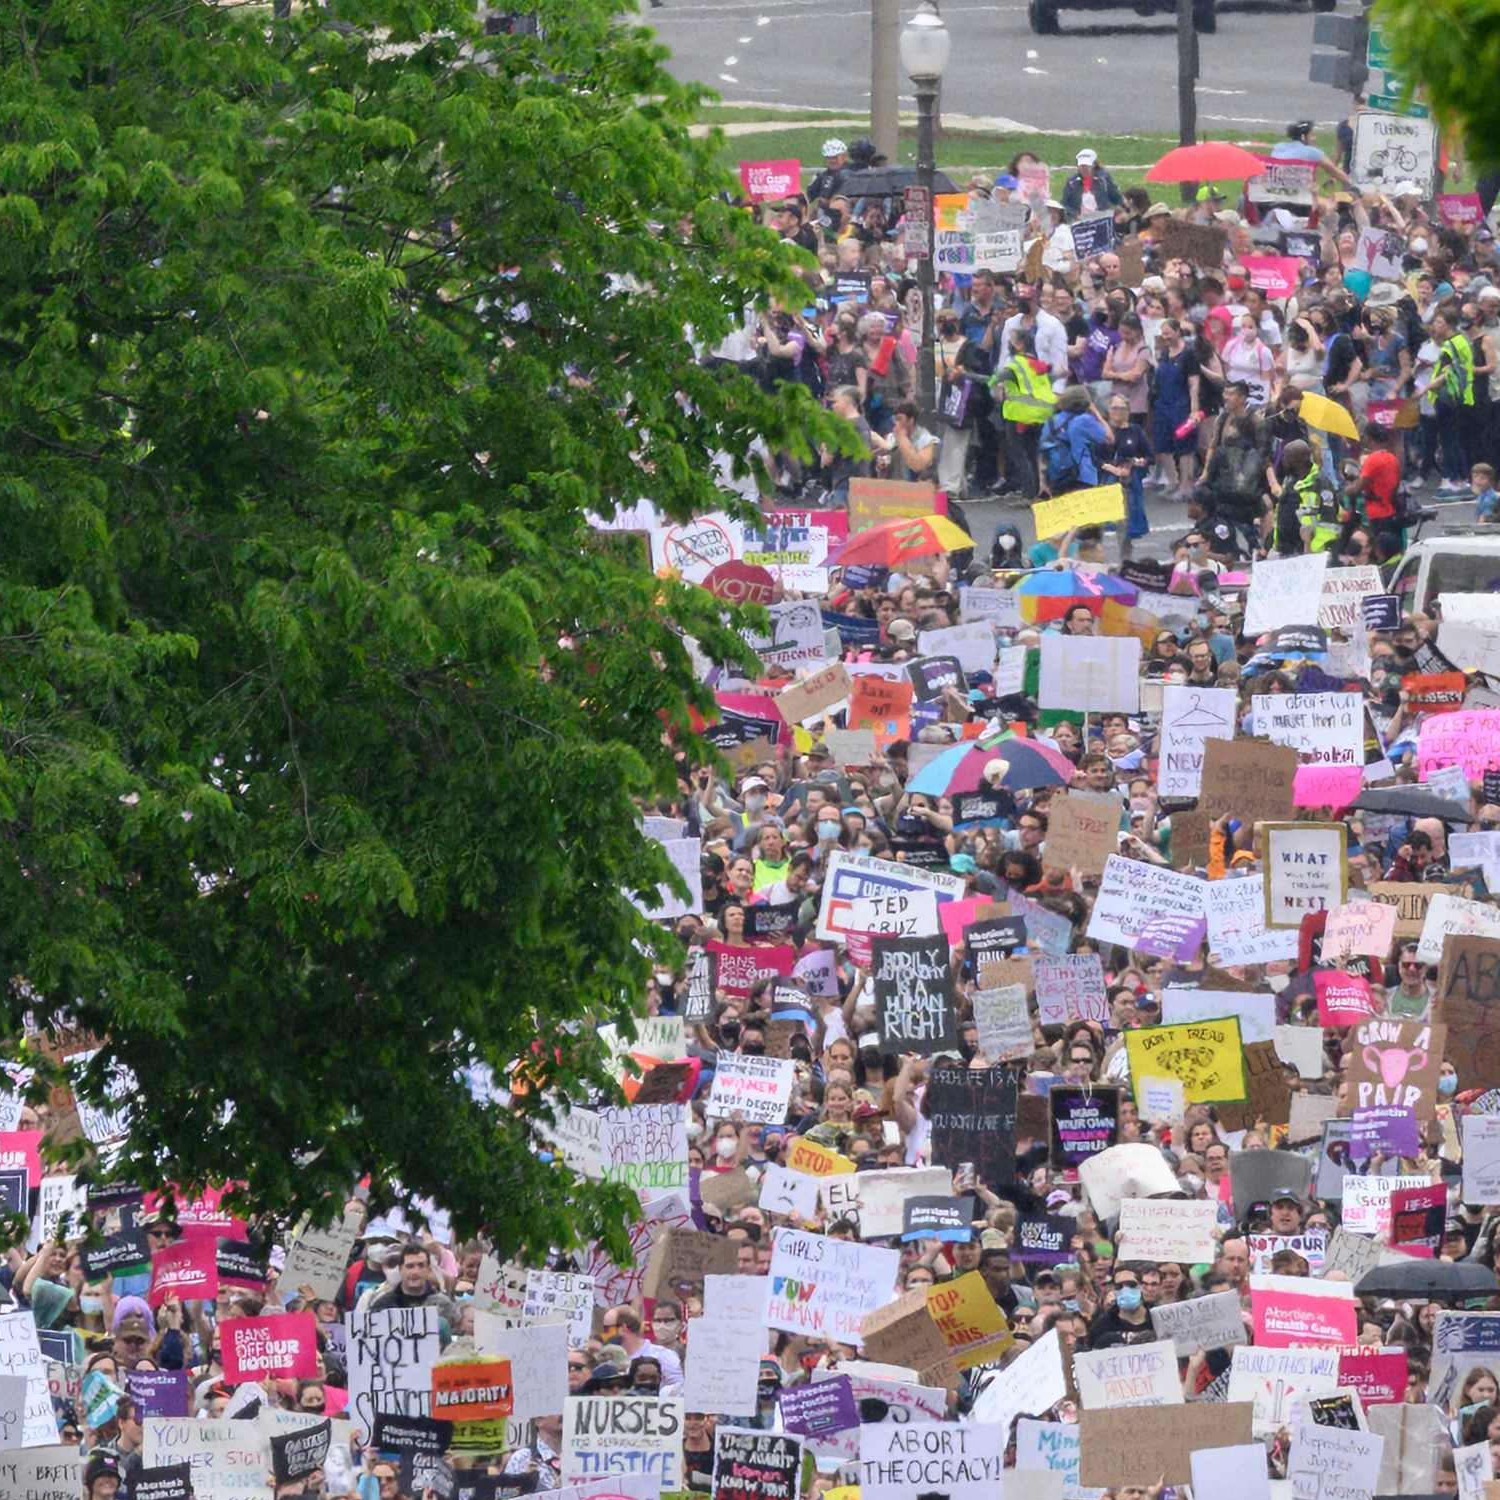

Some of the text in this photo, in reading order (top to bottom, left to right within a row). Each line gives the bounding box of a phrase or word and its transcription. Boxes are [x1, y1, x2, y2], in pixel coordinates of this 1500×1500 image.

[711, 577, 773, 603] VOTE
[1281, 852, 1328, 866] WHAT
[870, 896, 909, 916] TED
[1283, 895, 1327, 908] NEXT
[883, 949, 938, 969] BODILY
[897, 978, 930, 996] IS A
[886, 995, 944, 1014] HUMAN
[885, 1012, 944, 1038] RIGHT
[1356, 1021, 1429, 1051] GROW A
[1357, 1079, 1423, 1108] PAIR
[1250, 1236, 1325, 1252] NOT YOUR
[234, 1327, 271, 1342] BANS
[237, 1353, 294, 1369] BODIES
[358, 1338, 421, 1365] NOT
[371, 1365, 410, 1391] BE
[436, 1385, 509, 1406] MAJORITY
[573, 1401, 680, 1437] NURSES
[153, 1424, 190, 1443] YOU
[888, 1429, 969, 1454] ABORT
[576, 1450, 676, 1486] JUSTICE
[865, 1457, 1000, 1486] THEOCRACY!
